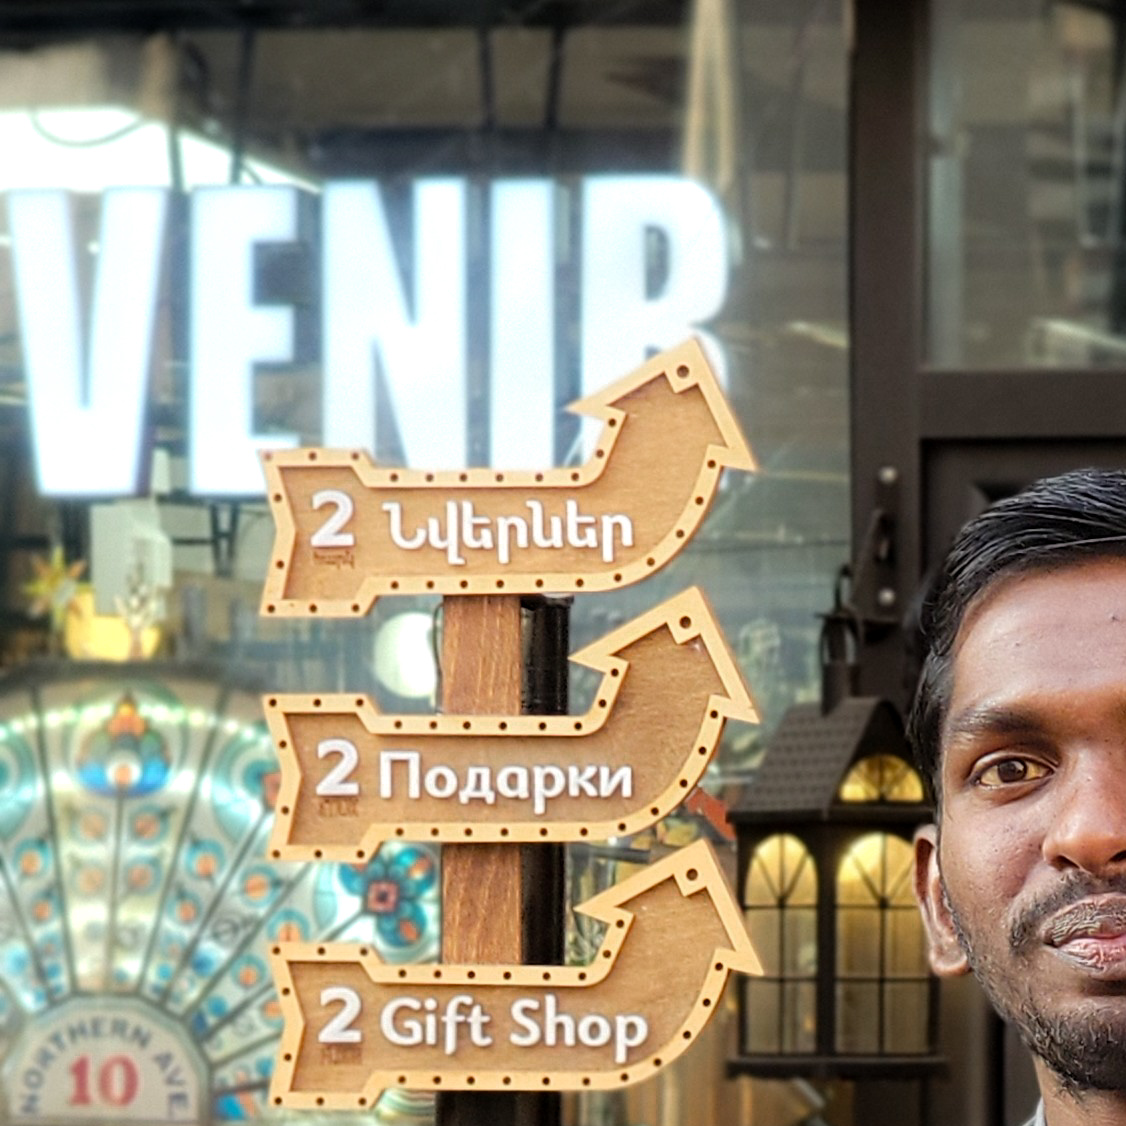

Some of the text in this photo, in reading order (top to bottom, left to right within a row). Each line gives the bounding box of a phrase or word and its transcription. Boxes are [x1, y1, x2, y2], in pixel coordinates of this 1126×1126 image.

[310, 490, 634, 565] 2 Նվերներ
[315, 738, 633, 815] 2 Подарки
[317, 986, 649, 1063] 2 Gift Shop
[19, 1016, 151, 1116] NORTHERN
[69, 1054, 139, 1107] 10
